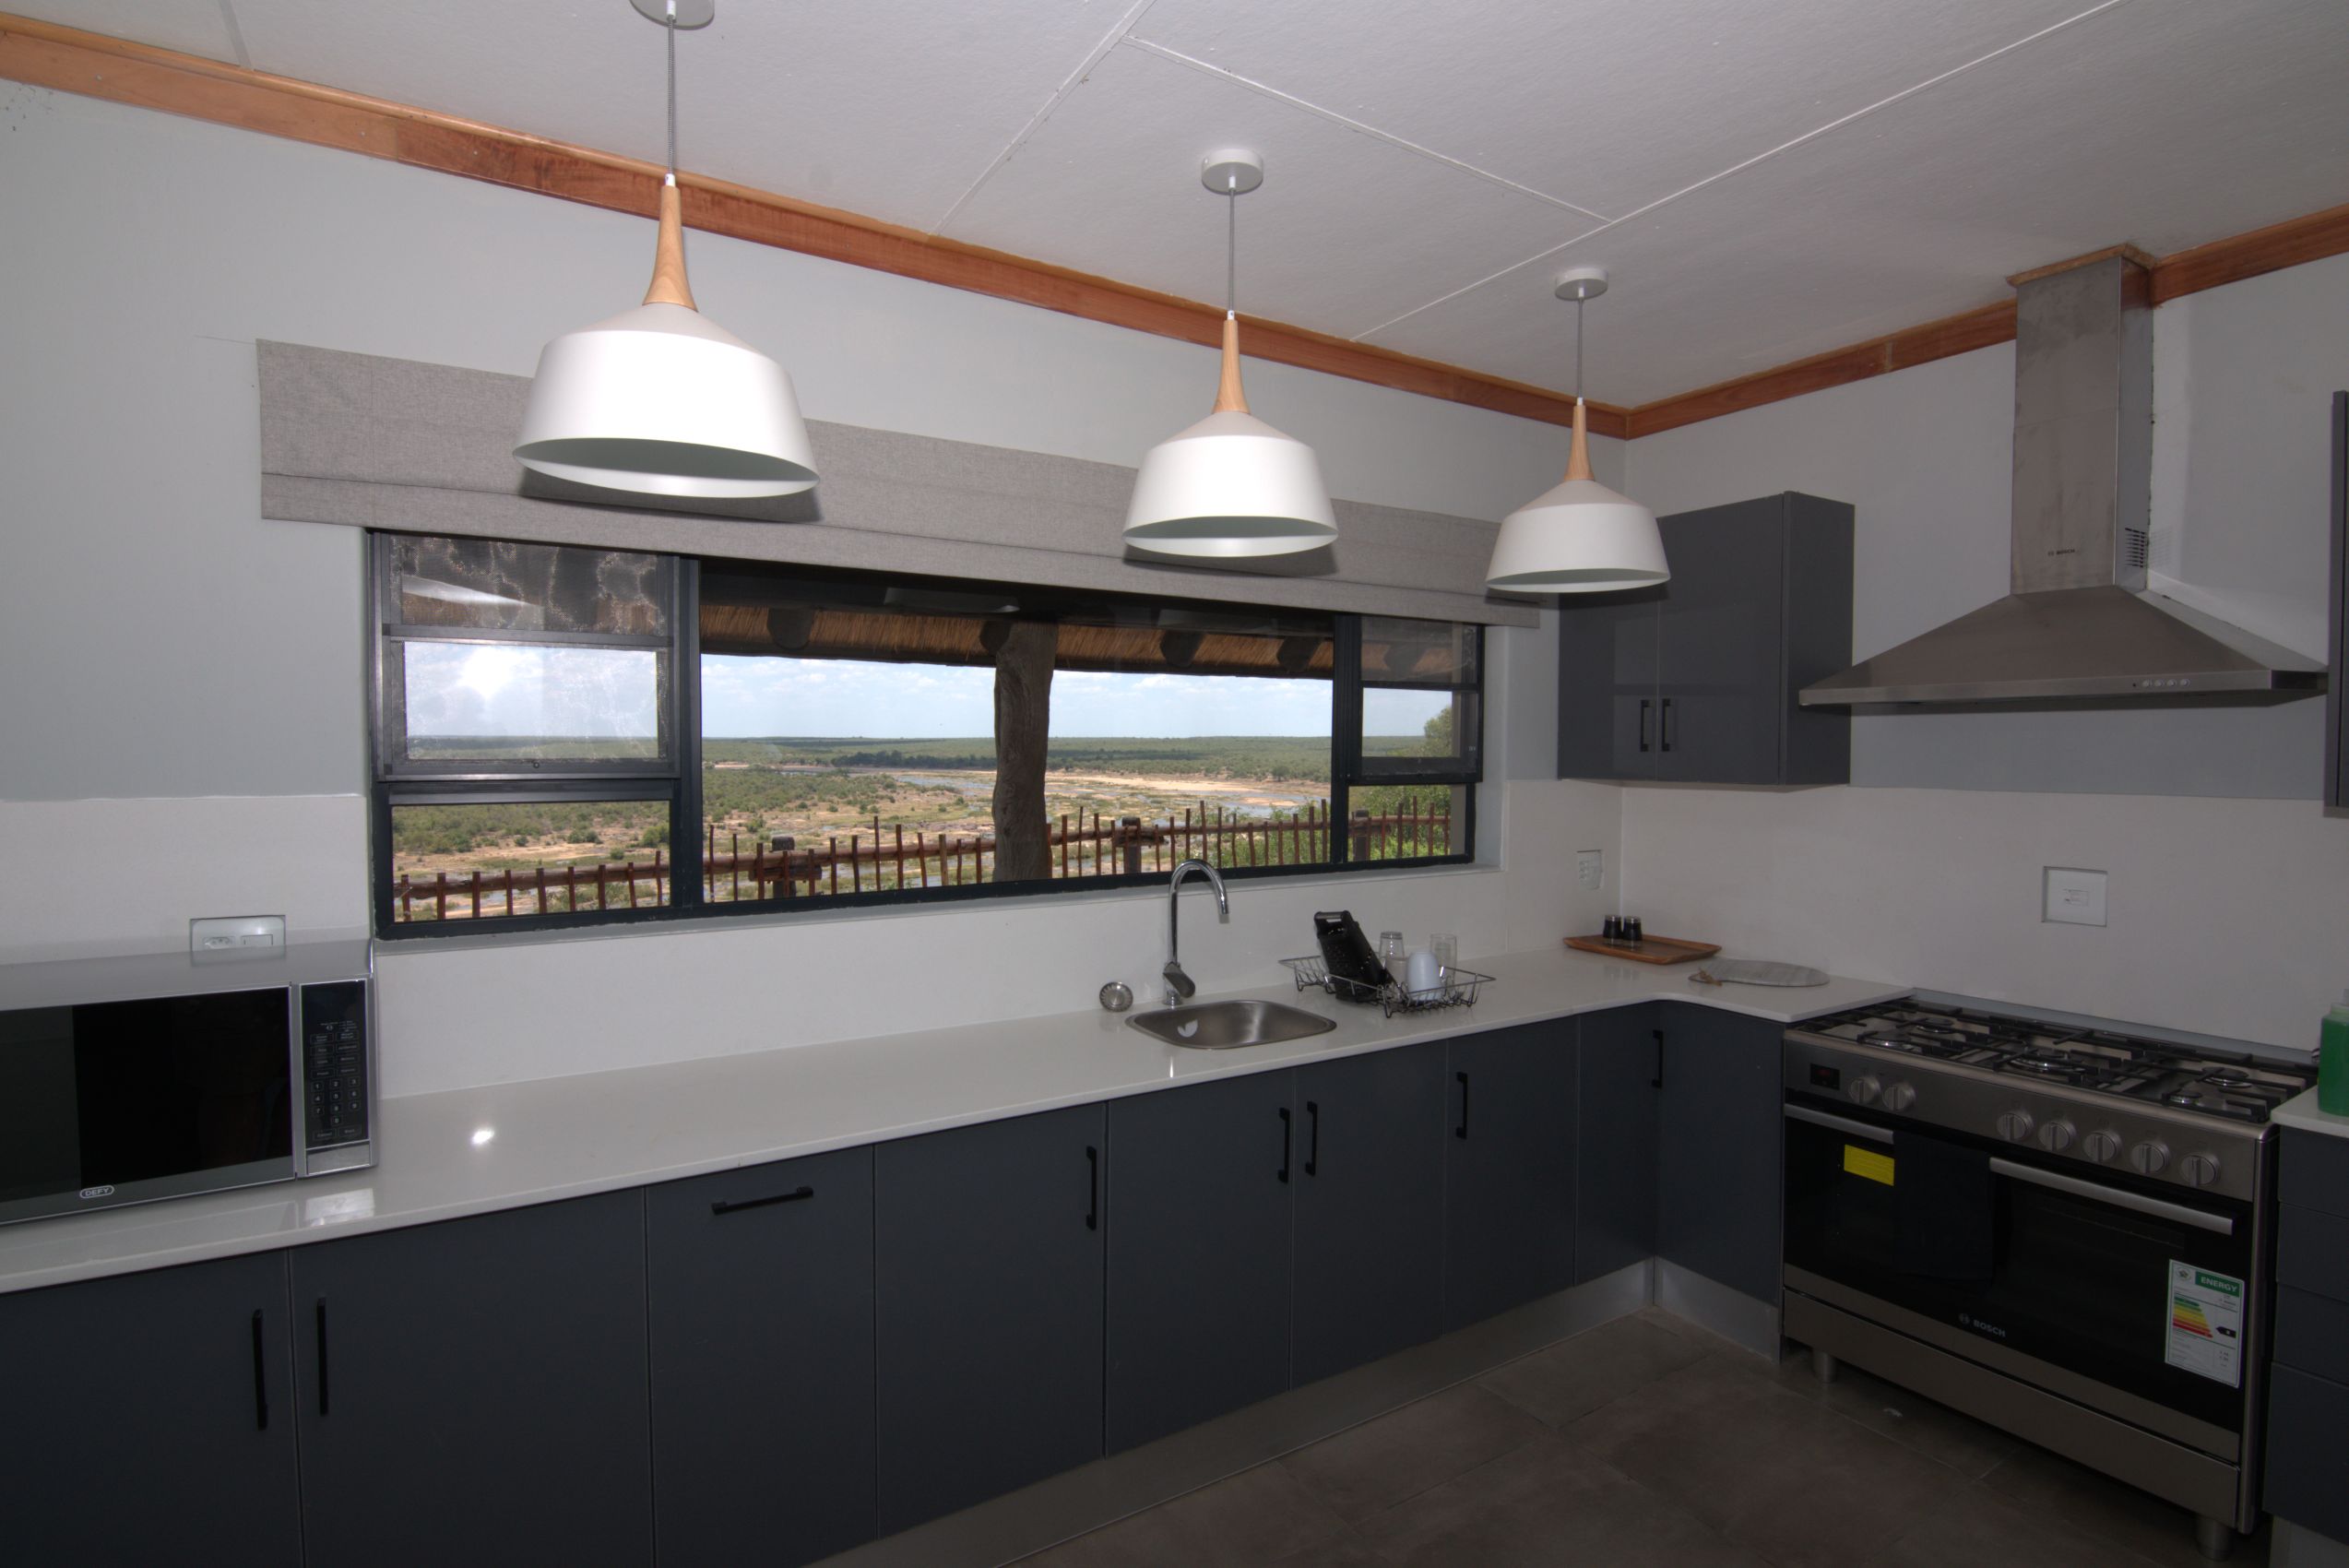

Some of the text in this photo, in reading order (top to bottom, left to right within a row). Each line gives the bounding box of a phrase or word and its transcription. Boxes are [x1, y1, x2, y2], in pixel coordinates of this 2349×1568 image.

[85, 1187, 110, 1196] DEFY
[2200, 1277, 2238, 1292] ENERGY
[1973, 1319, 2006, 1337] BOSCH
